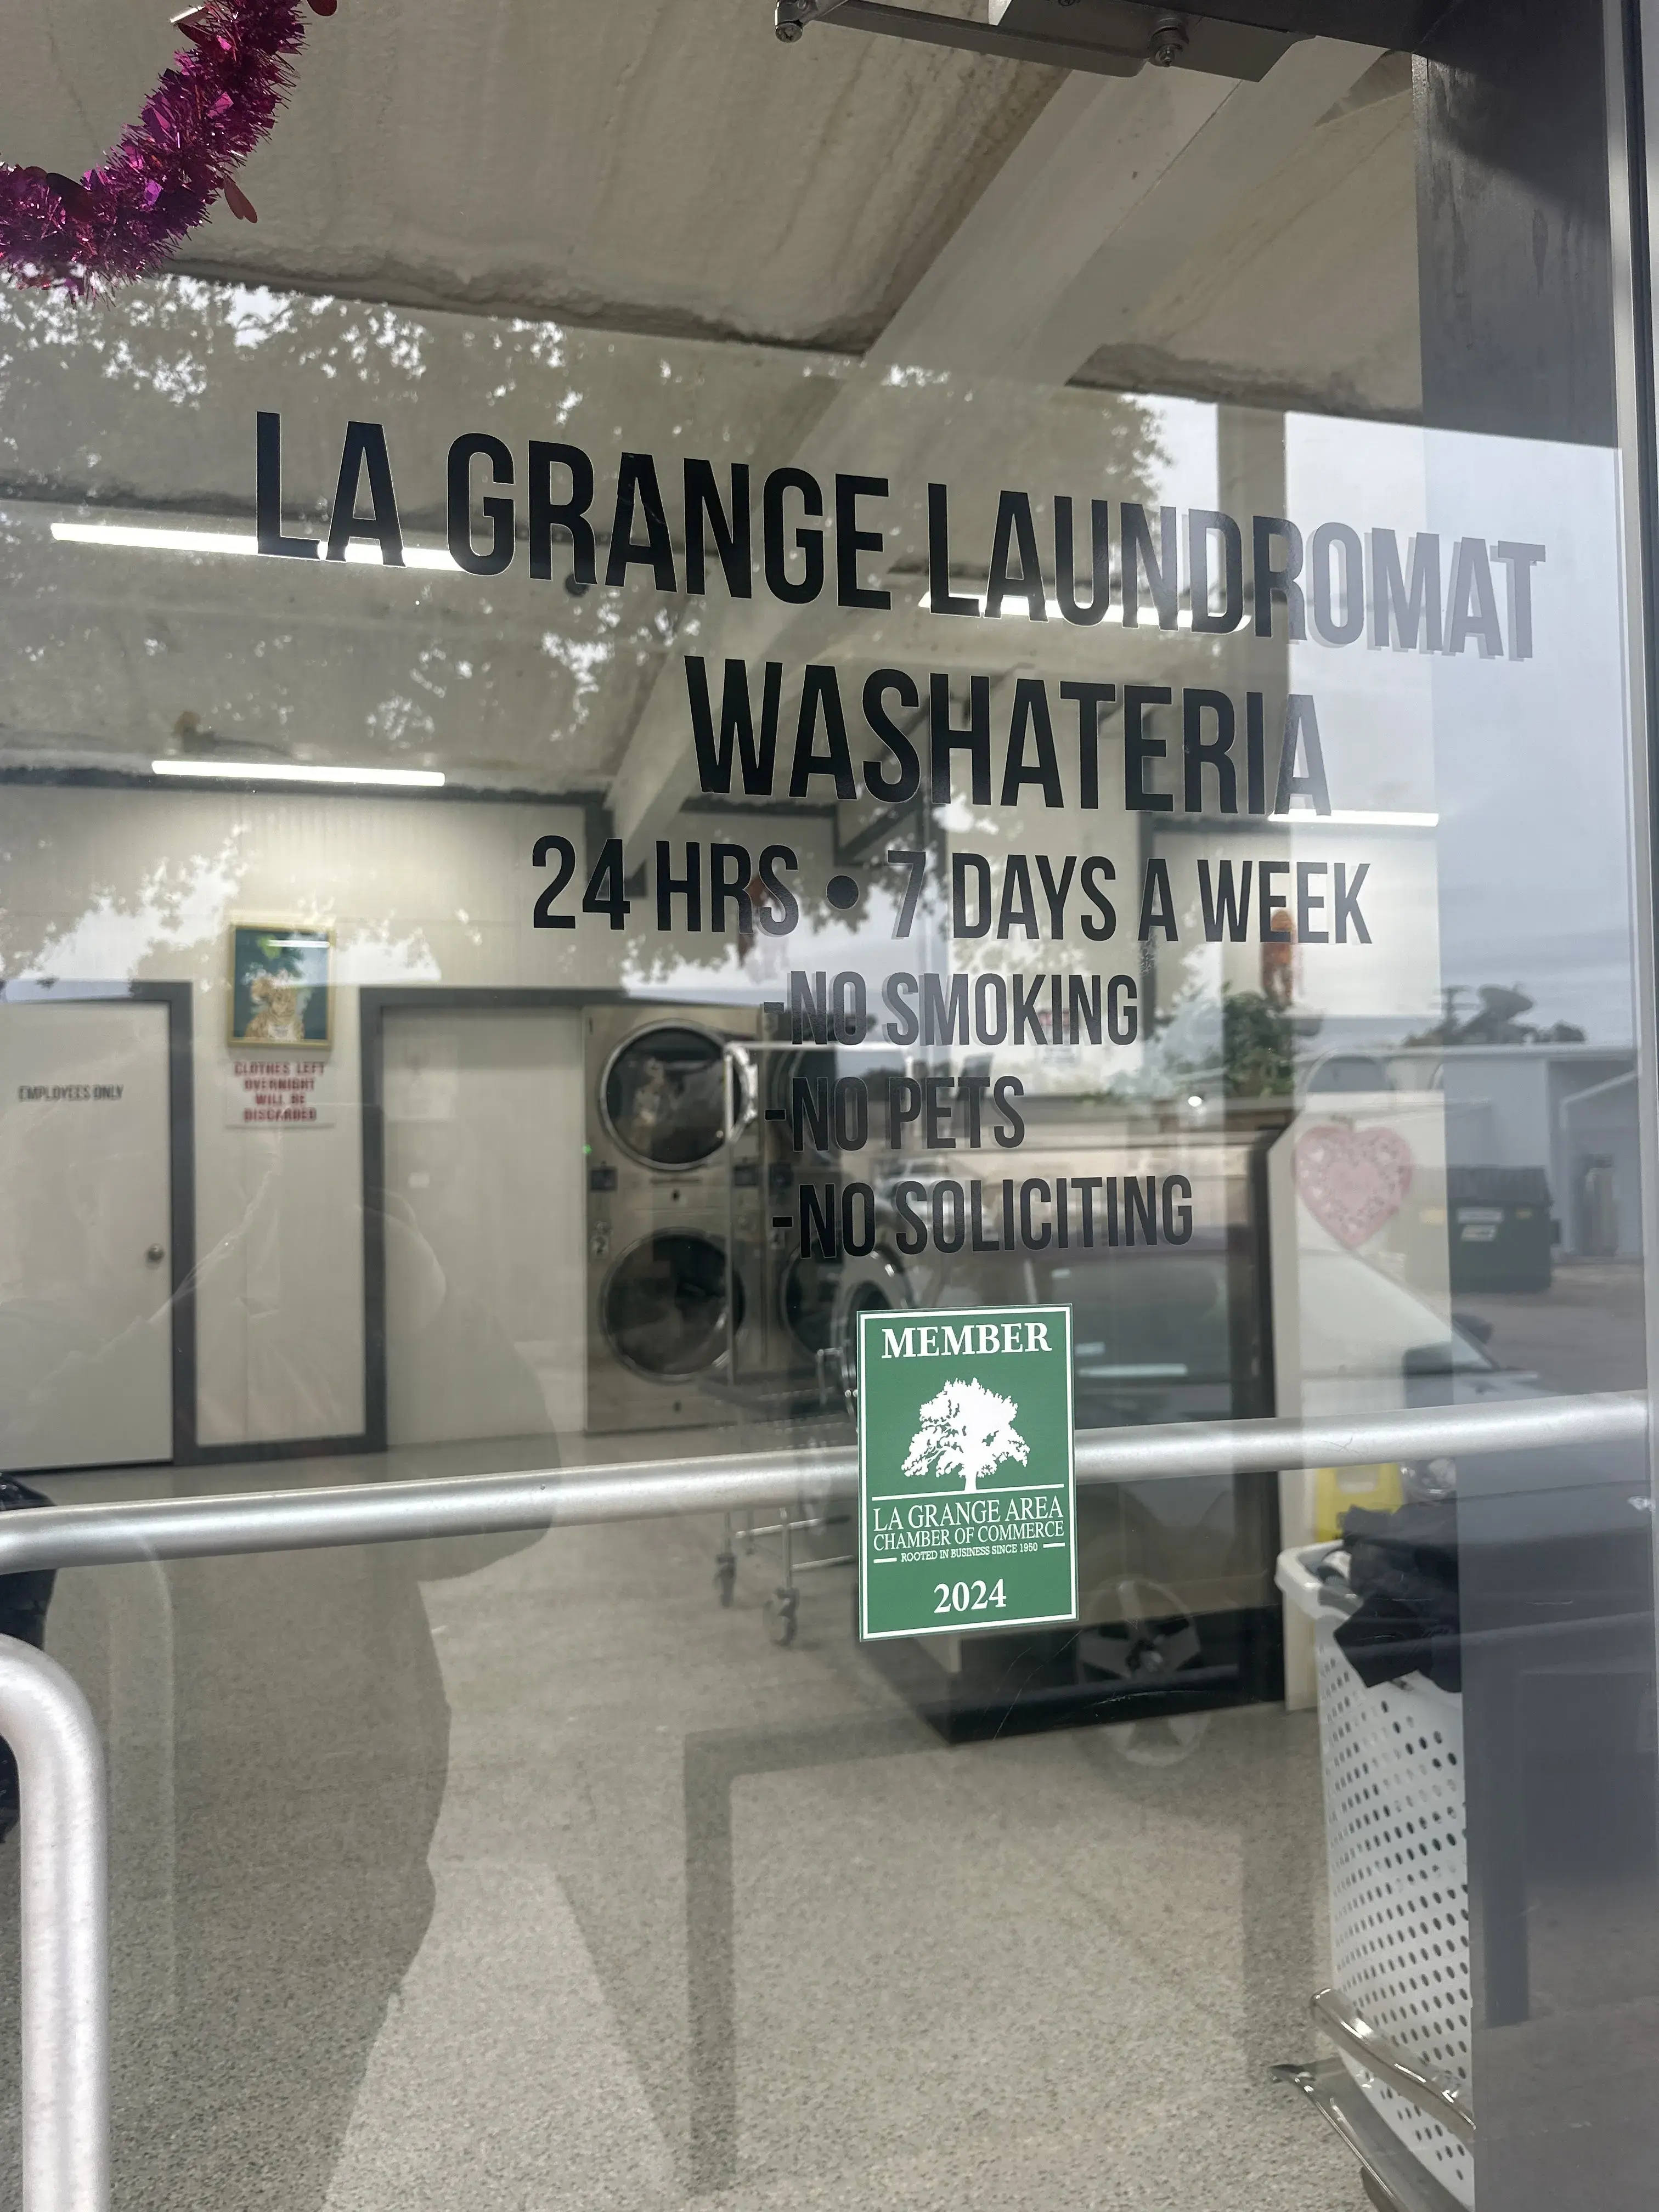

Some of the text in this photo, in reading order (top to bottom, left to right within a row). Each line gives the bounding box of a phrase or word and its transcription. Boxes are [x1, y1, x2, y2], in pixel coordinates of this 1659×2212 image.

[256, 410, 1546, 658] LA GRANGE LAUNDROMAT
[684, 655, 1331, 816] WASHATERIA
[532, 835, 1373, 944] 24 HRS 7 DAYS A WEEK
[764, 970, 867, 1045] -NO
[884, 972, 1138, 1046] SMOKING
[234, 1060, 325, 1075] CLOTHES LEFT
[244, 1077, 314, 1091] OVERNIGHT
[18, 1084, 125, 1102] EMPLOYEES ONLY
[255, 1093, 306, 1105] WILL BE
[244, 1107, 317, 1121] DISCARDED
[765, 1076, 1025, 1152] -NO PETS
[772, 1175, 1193, 1259] -NO SOLICITING
[881, 1322, 1052, 1359] MEMBER
[873, 1496, 1064, 1532] LA GRANGE AREA
[873, 1520, 1064, 1551] CHAMBER OF COMMERCE
[901, 1542, 1039, 1562] ROOTED IN BUSINESS SINCE 1950
[934, 1578, 1007, 1614] 2024
